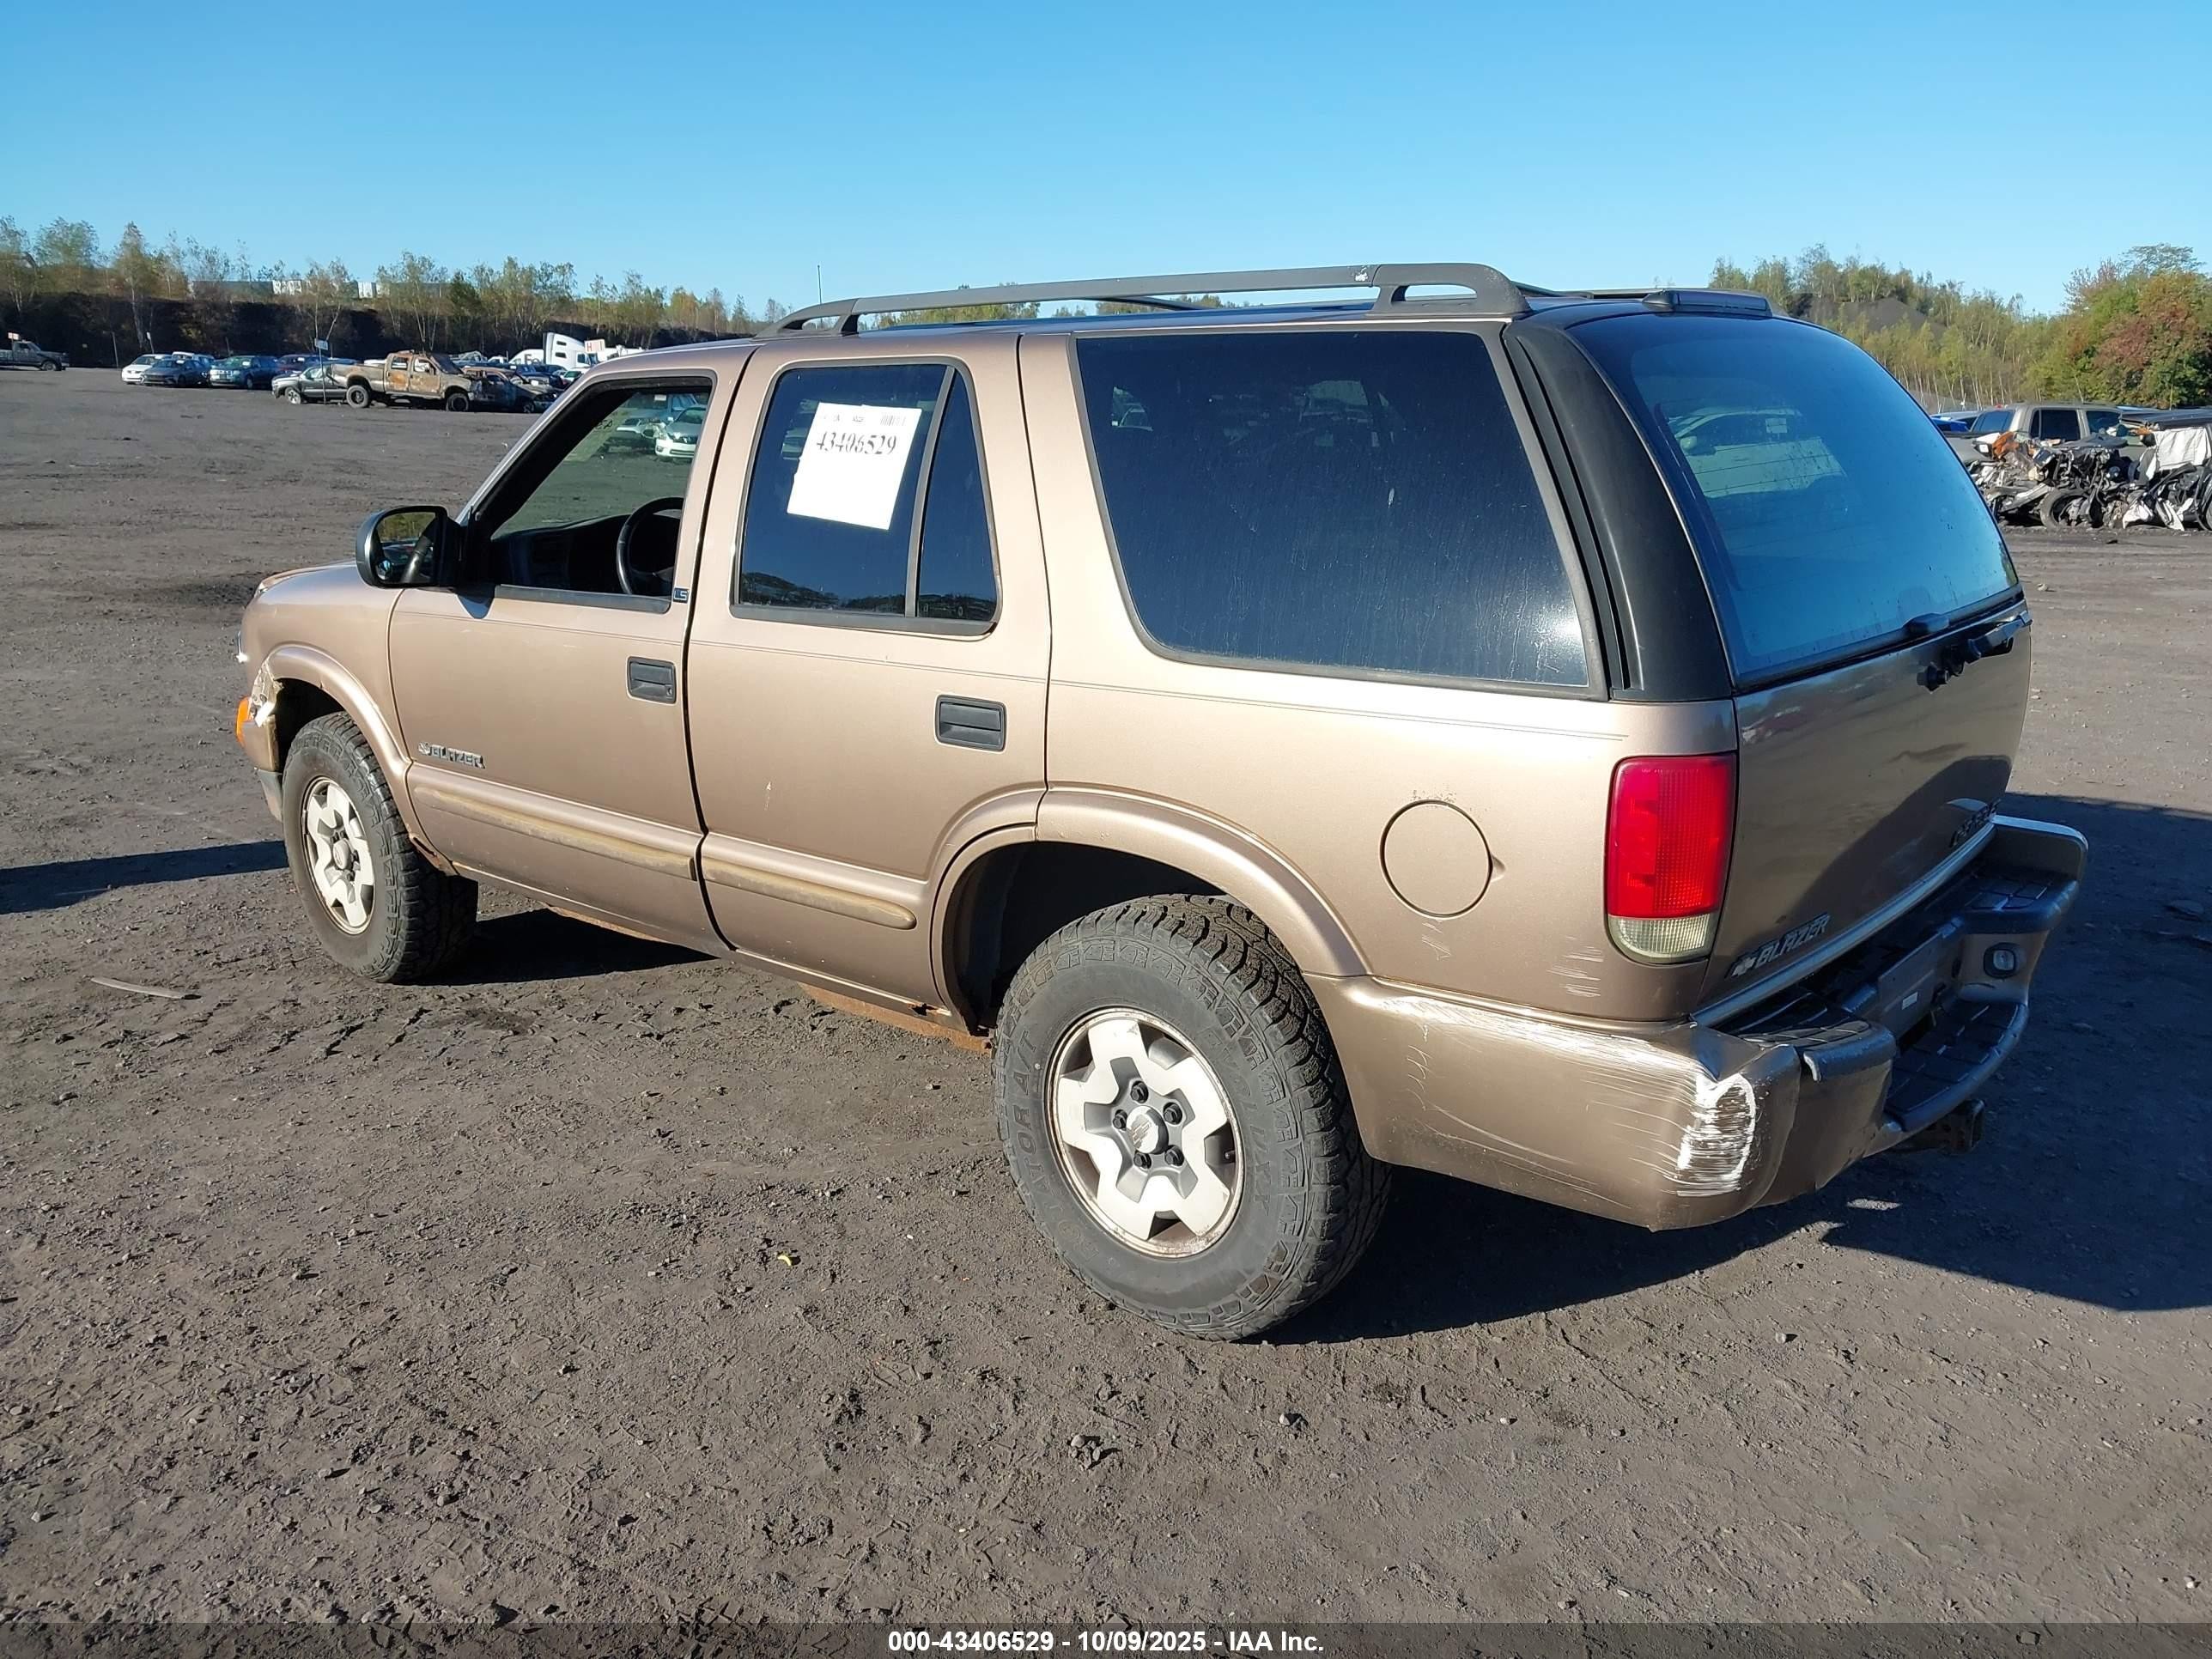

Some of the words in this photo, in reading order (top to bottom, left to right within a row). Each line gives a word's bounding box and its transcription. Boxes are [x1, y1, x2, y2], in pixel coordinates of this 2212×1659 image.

[816, 430, 897, 455] 43406529
[430, 744, 486, 769] BLAZER
[1754, 914, 1831, 969] BLAZER
